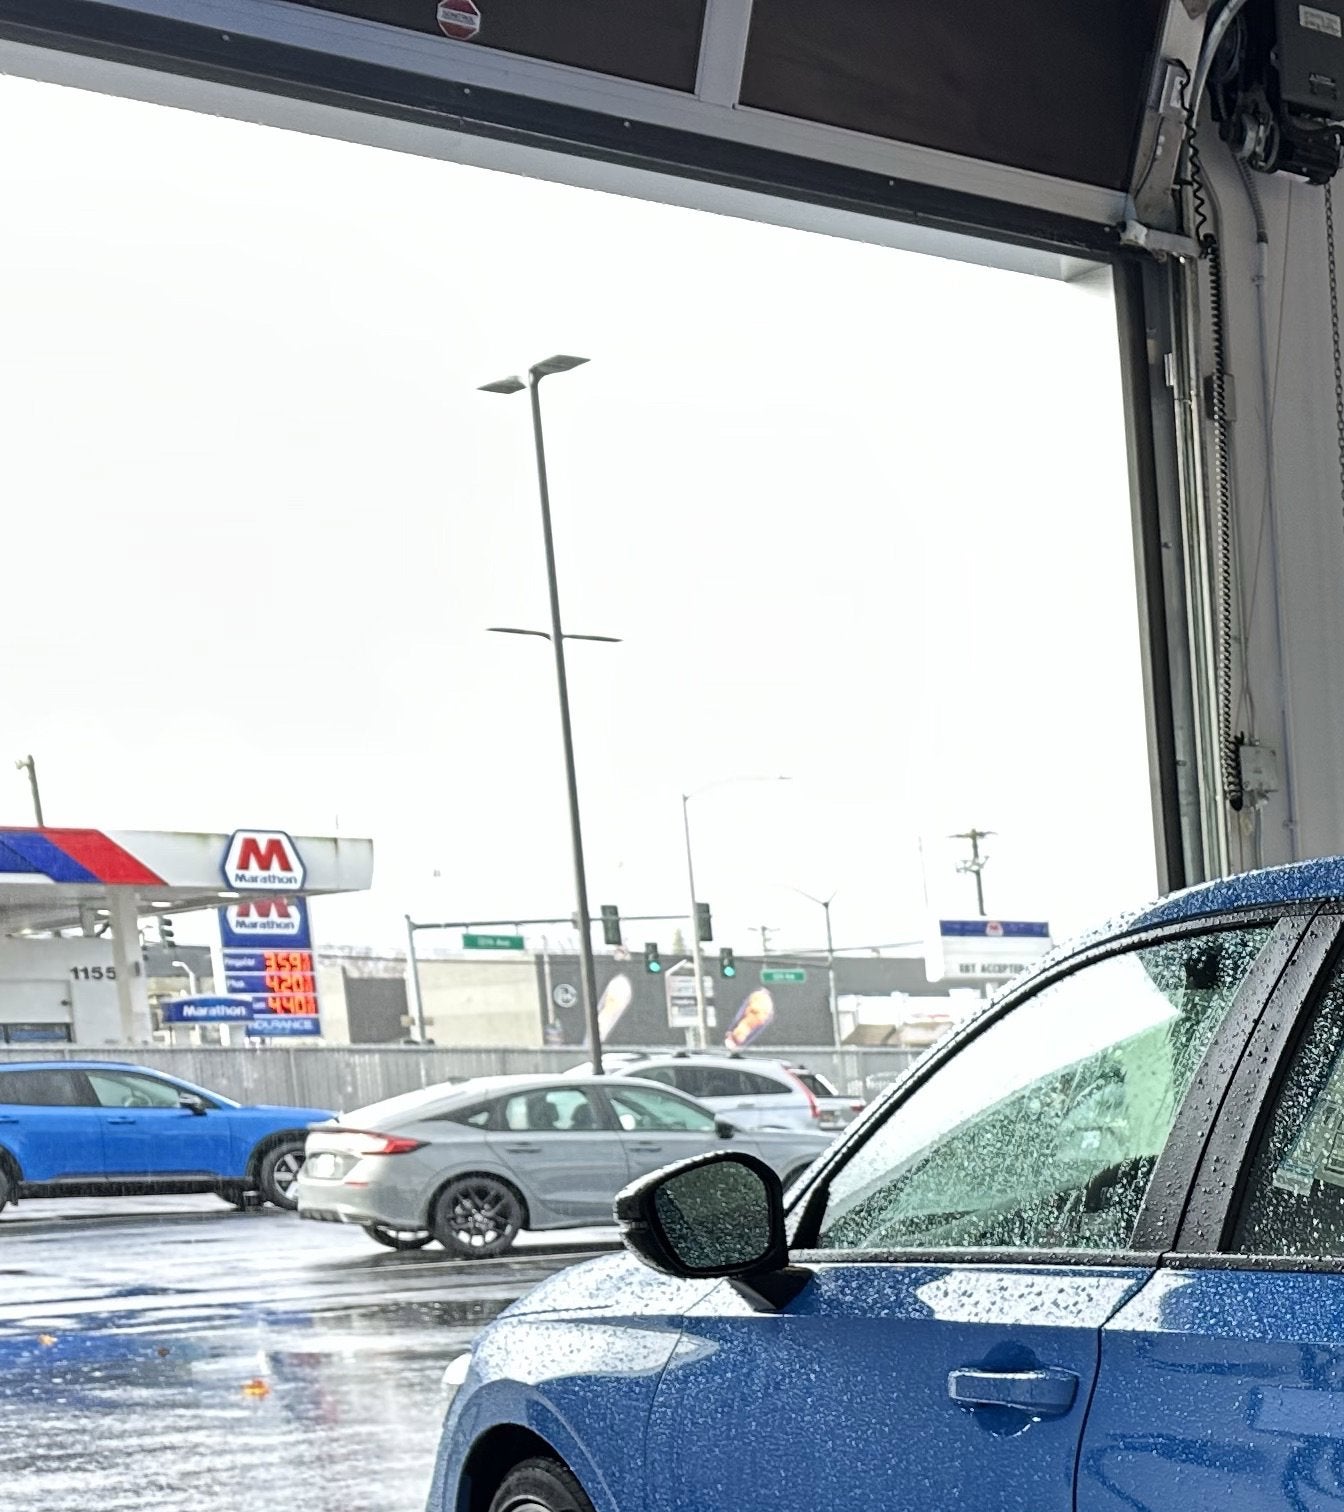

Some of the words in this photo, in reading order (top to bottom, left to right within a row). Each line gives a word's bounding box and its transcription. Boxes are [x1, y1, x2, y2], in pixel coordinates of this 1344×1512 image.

[235, 873, 298, 885] Marathon
[235, 920, 295, 930] Marathon
[70, 966, 117, 980] 1155
[183, 1005, 246, 1017] Marathon
